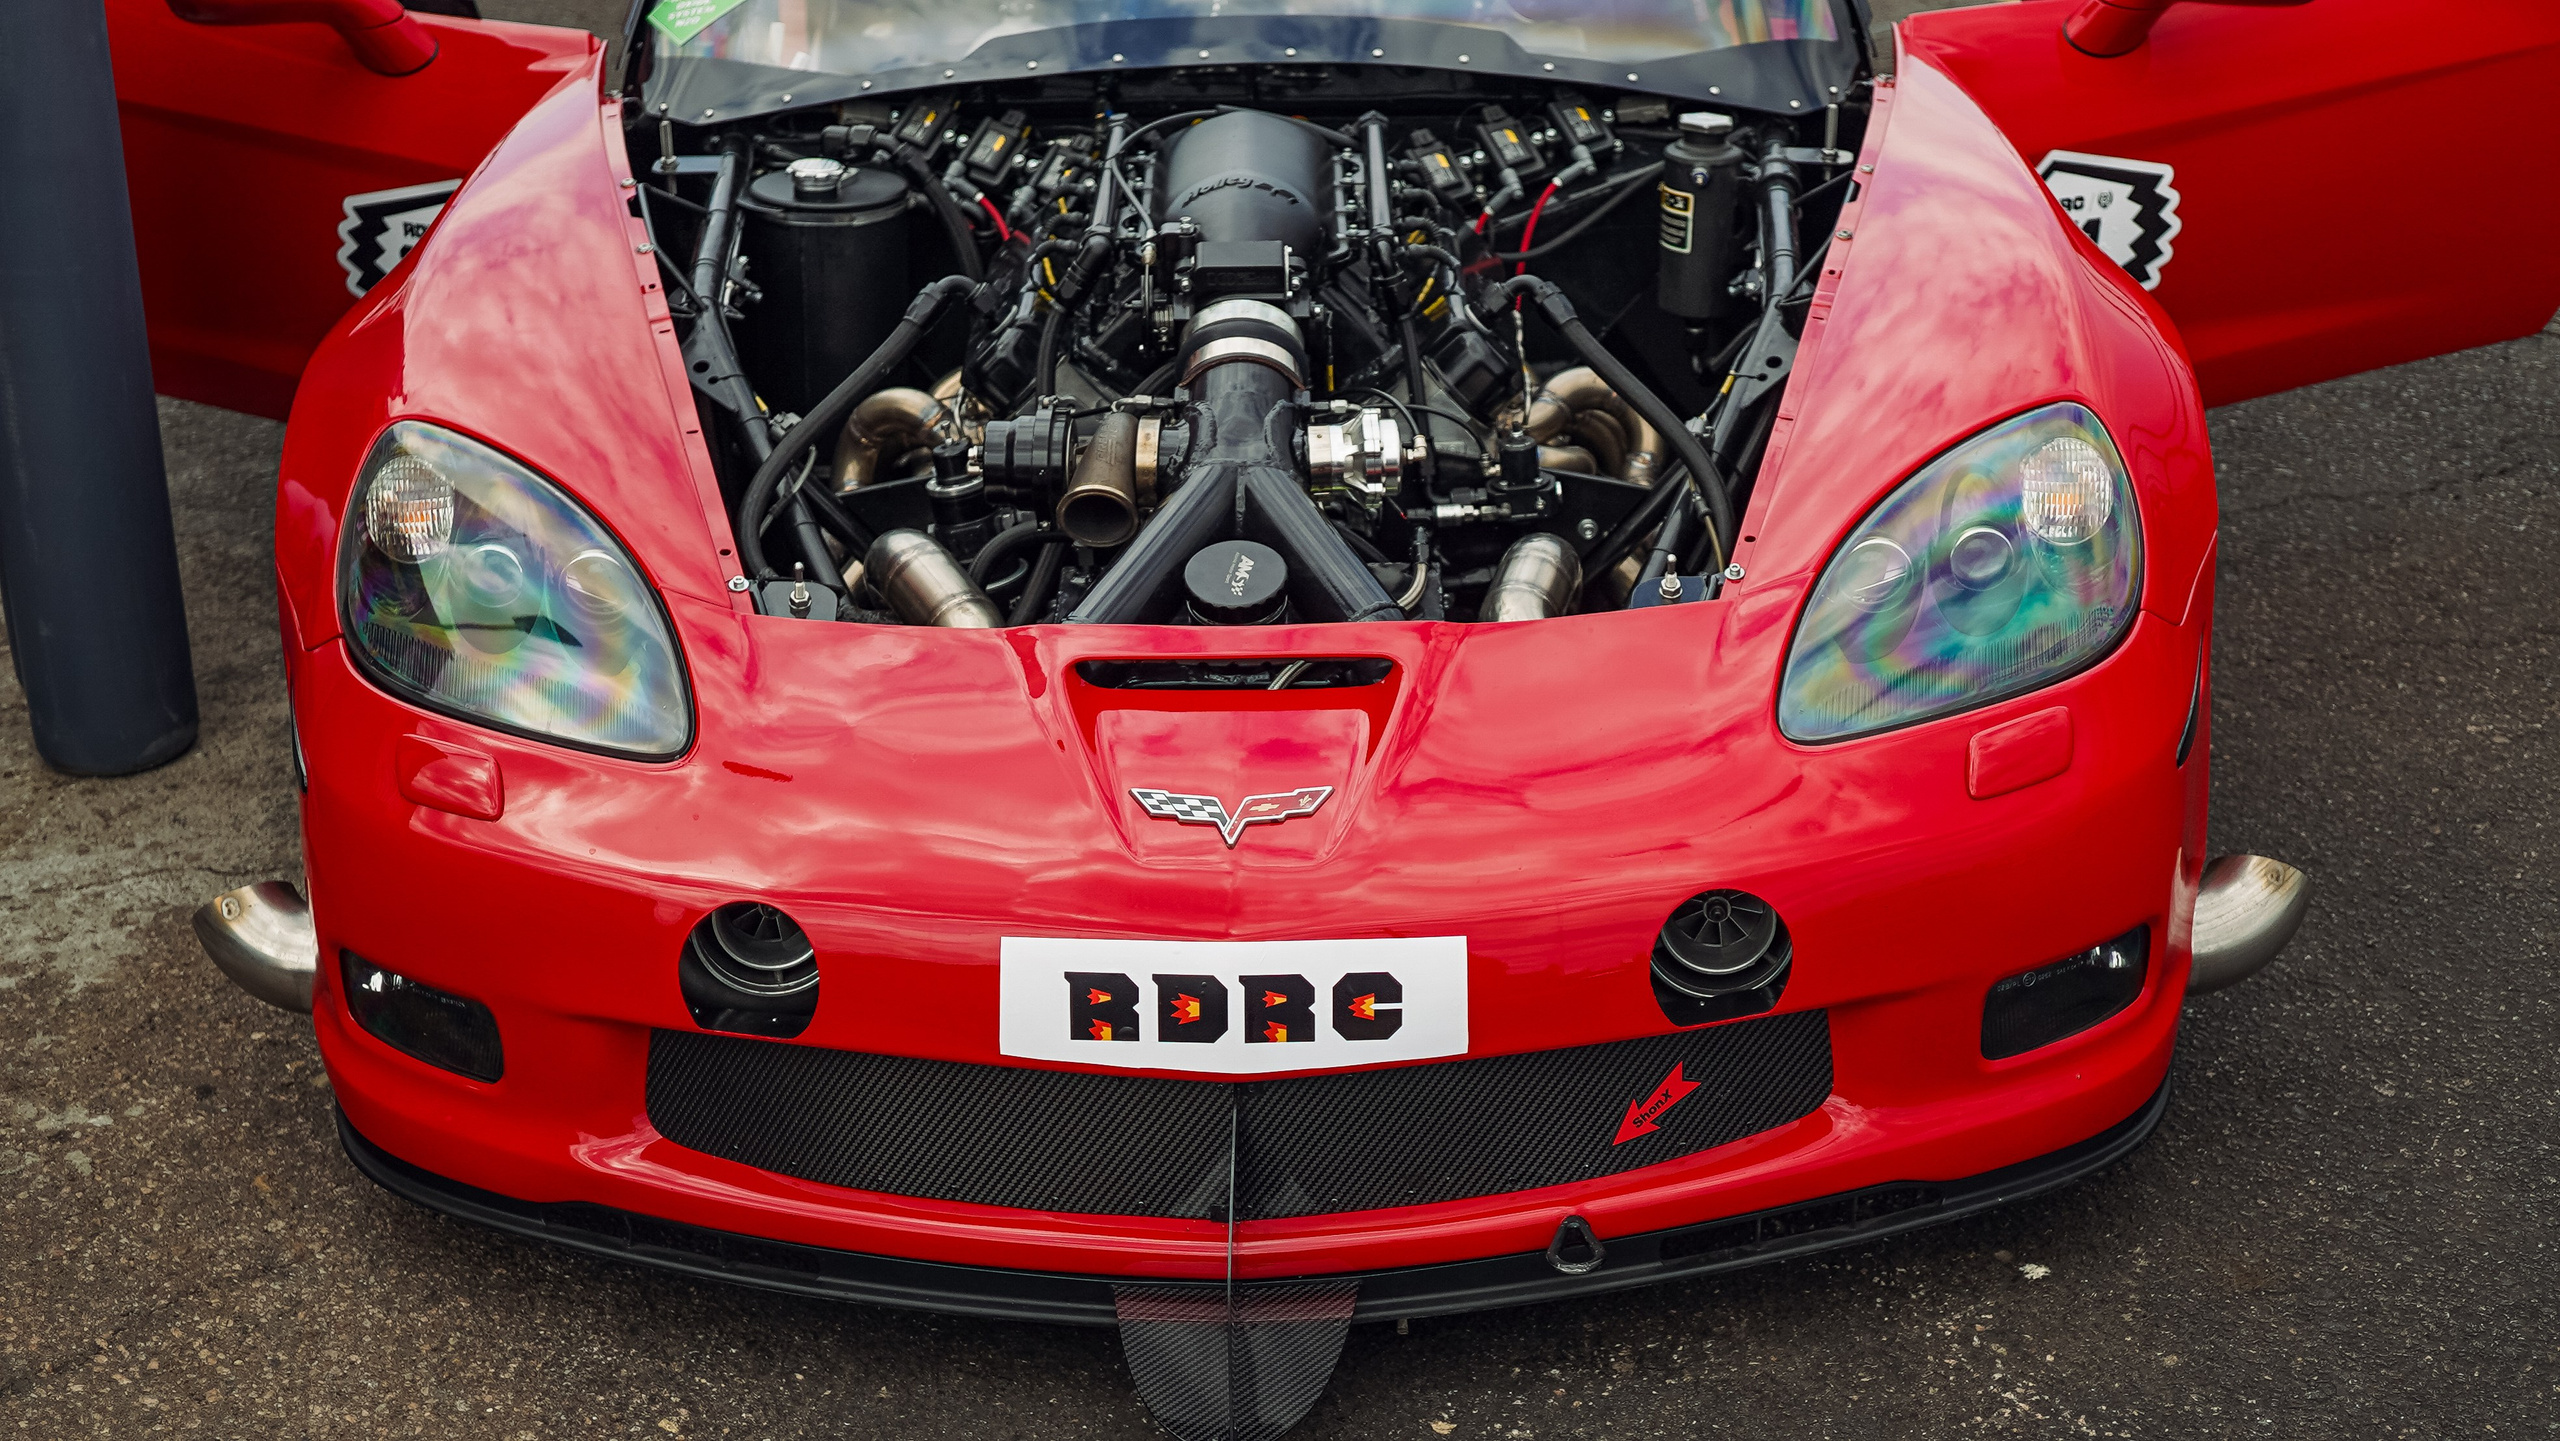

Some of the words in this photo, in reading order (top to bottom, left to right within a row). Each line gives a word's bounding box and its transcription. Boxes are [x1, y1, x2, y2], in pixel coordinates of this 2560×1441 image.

[2060, 195, 2084, 211] RC
[403, 221, 428, 238] RD
[1064, 971, 1404, 1044] RDRC
[1632, 1088, 1673, 1129] ShonX
